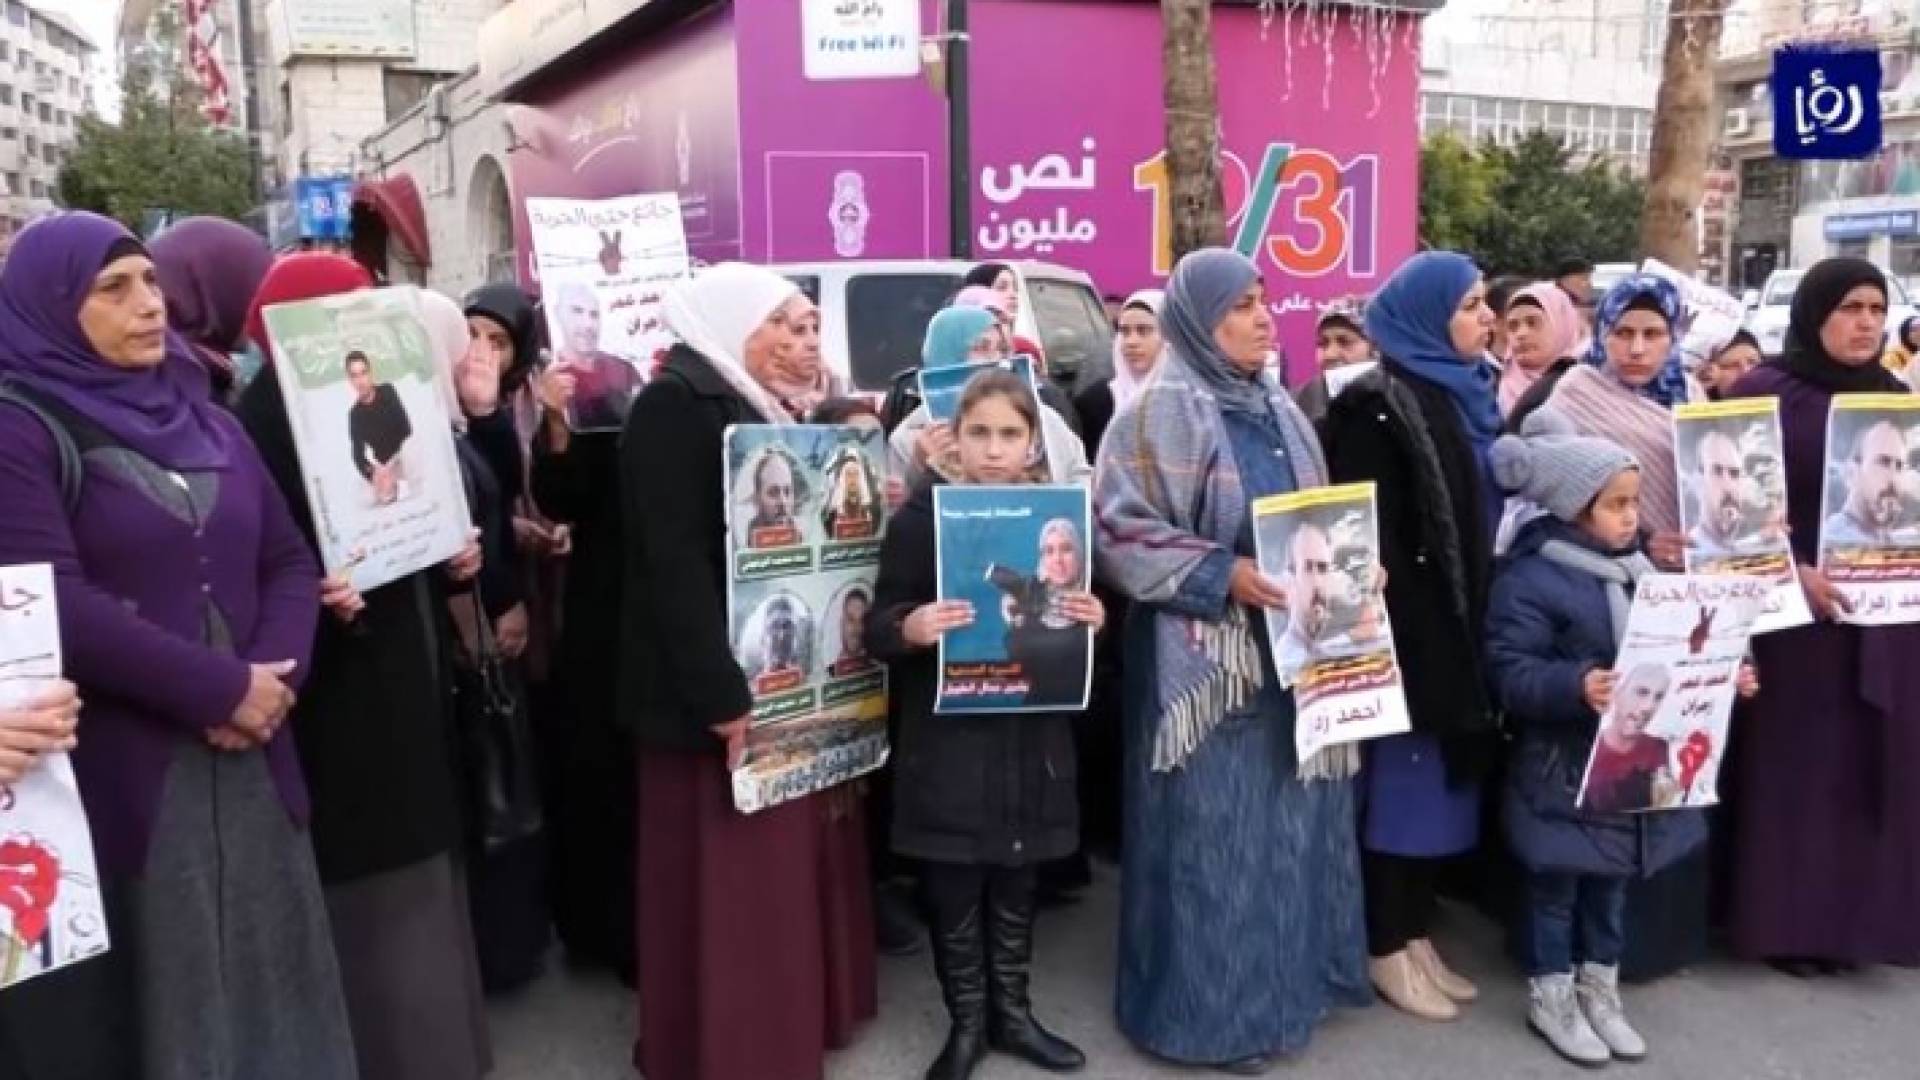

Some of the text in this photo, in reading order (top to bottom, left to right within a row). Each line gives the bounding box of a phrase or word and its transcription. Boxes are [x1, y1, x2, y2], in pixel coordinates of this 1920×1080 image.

[818, 35, 857, 51] Free
[980, 137, 1096, 202] نص
[979, 208, 1097, 250] مليون
